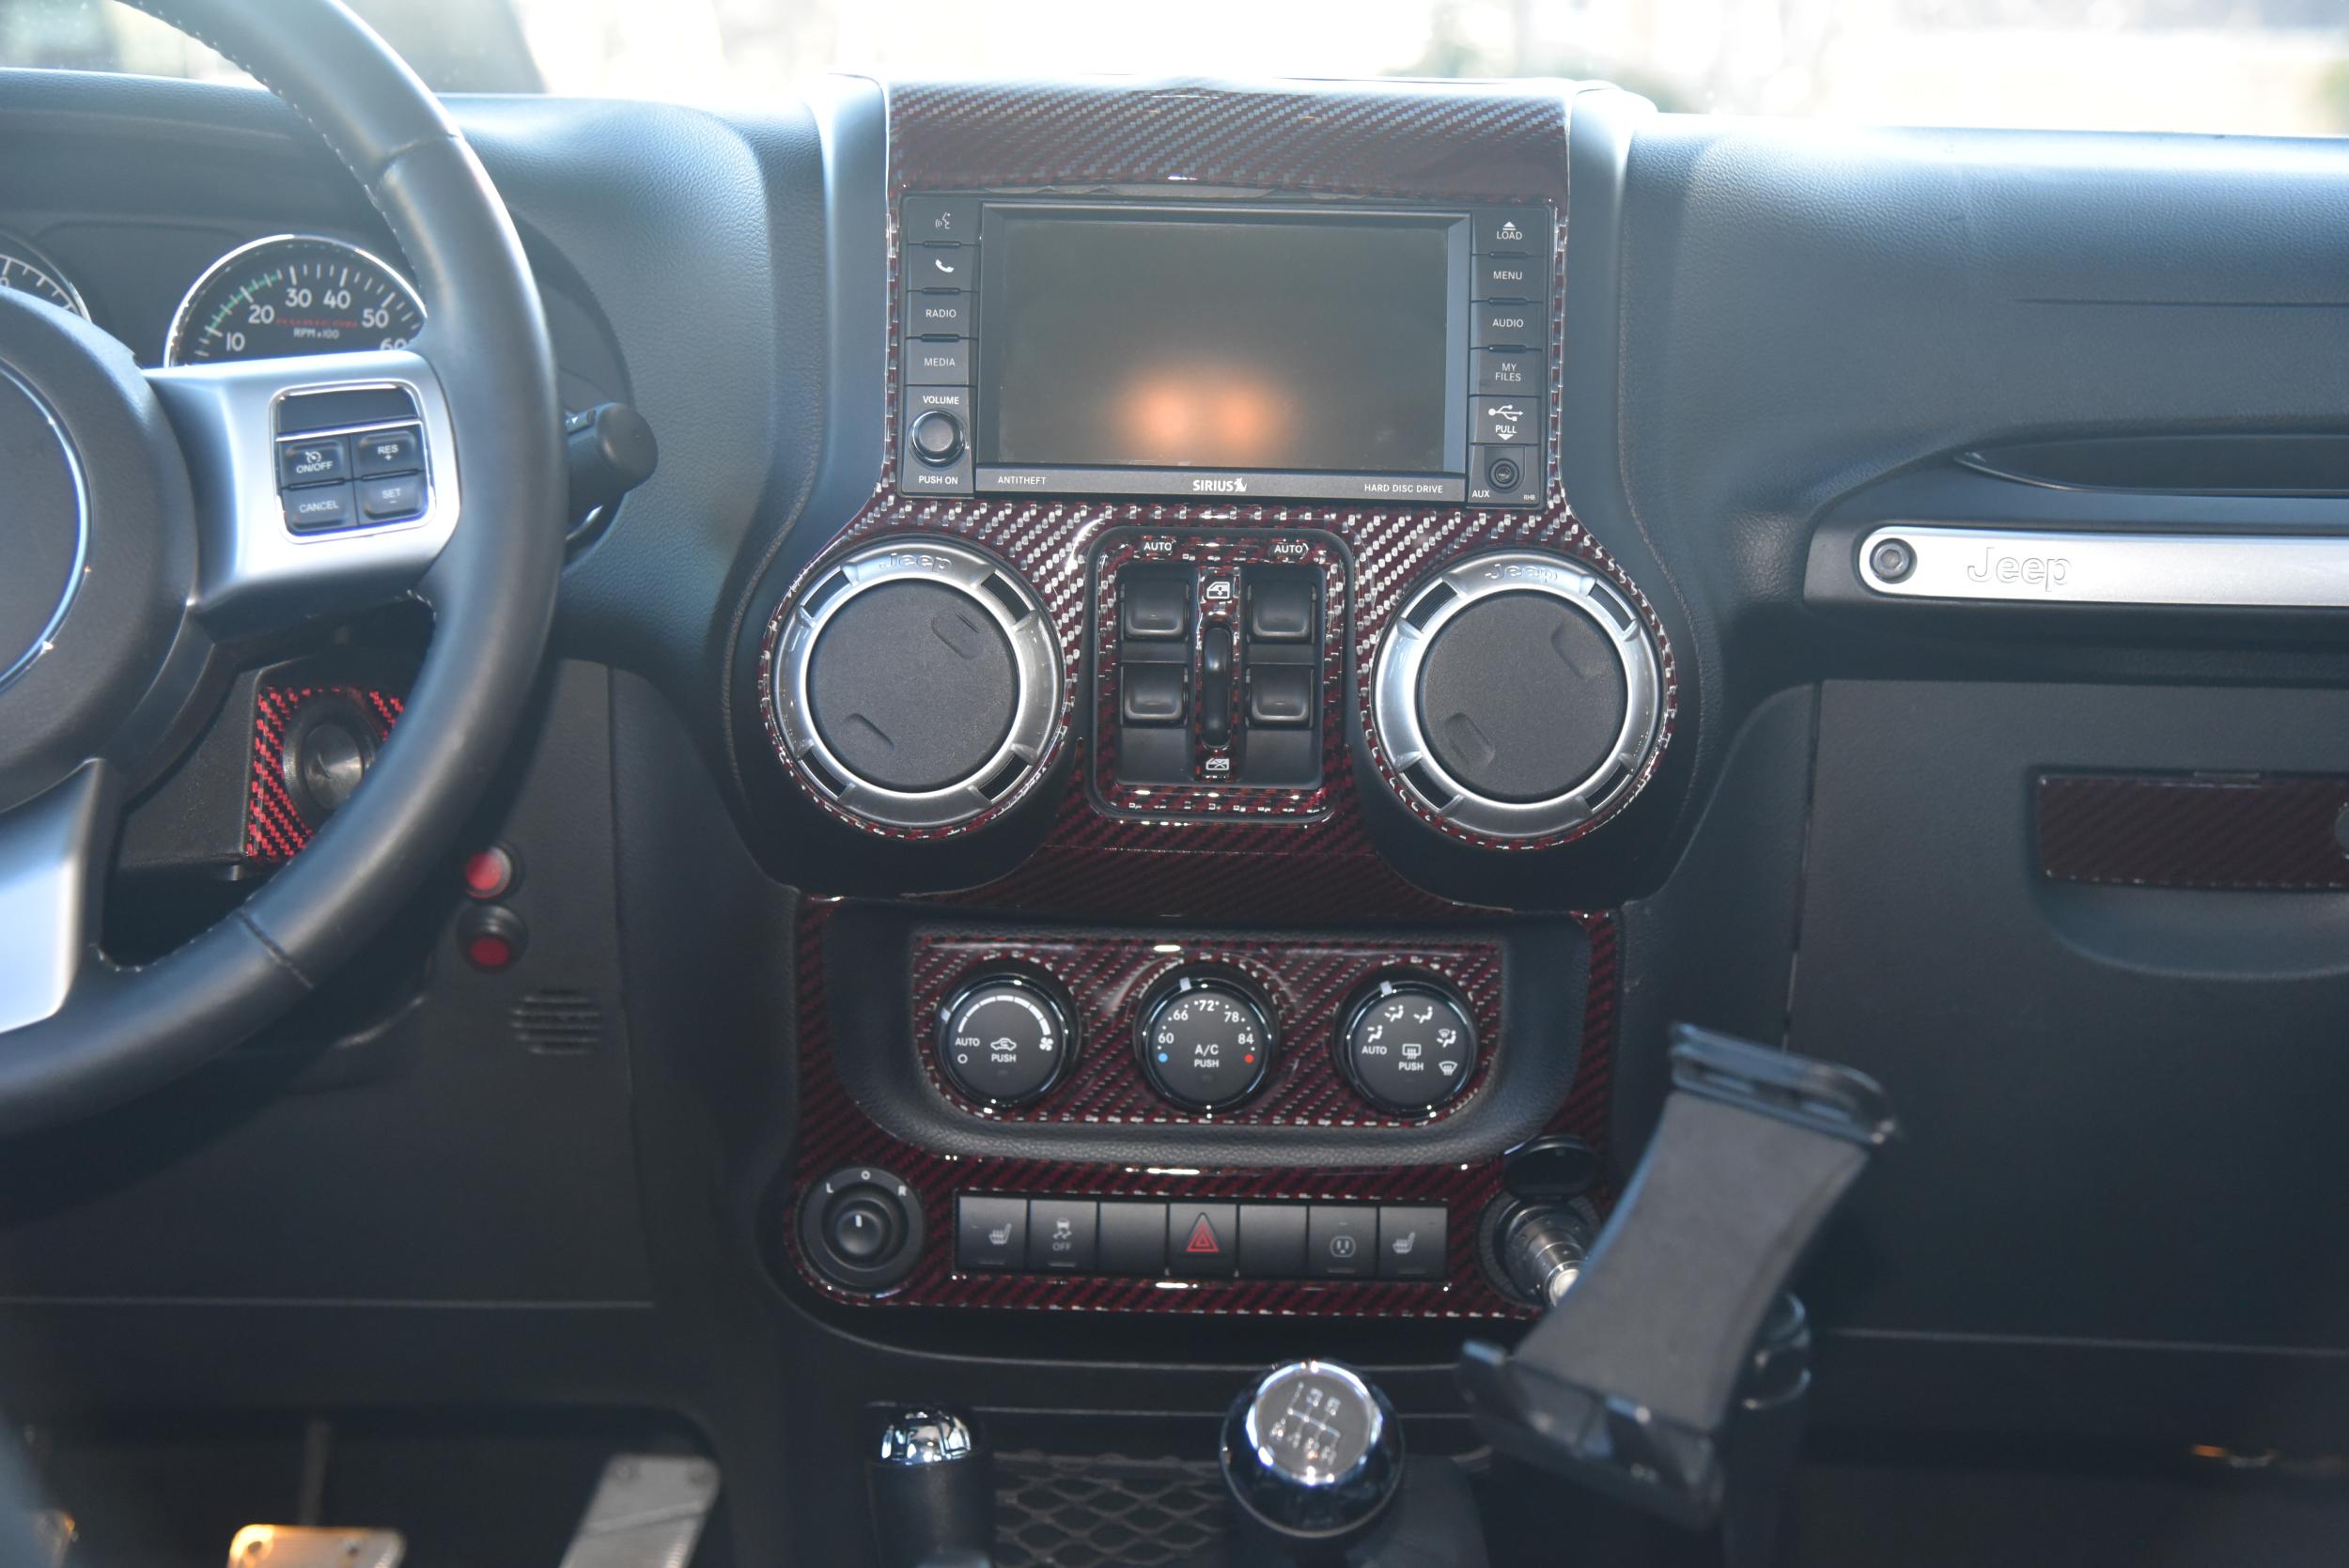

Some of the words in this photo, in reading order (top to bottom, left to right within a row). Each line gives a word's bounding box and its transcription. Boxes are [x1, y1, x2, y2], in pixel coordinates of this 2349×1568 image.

[1496, 230, 1523, 241] LOAD
[1492, 271, 1523, 281] MENU
[285, 287, 312, 308] 30
[323, 289, 350, 309] 40
[248, 304, 275, 324] 20
[362, 308, 389, 328] 50
[925, 308, 957, 318] RADIO
[1492, 318, 1524, 329] AUDIO
[293, 326, 316, 338] RPM
[226, 332, 245, 352] 10
[924, 357, 956, 367] MEDIA
[1501, 363, 1517, 372] MY
[1495, 372, 1522, 381] FILES
[923, 395, 959, 405] VOLUME
[1495, 424, 1517, 434] PULL
[377, 443, 399, 455] RES
[296, 460, 334, 474] ON/OFF
[918, 474, 942, 485] PUSH
[944, 475, 958, 485] ON
[997, 475, 1047, 486] ANTITHEFT
[1192, 479, 1234, 492] SIRIUS
[1364, 483, 1390, 492] HARD
[1392, 484, 1414, 493] DISC
[1416, 484, 1443, 494] DRIVE
[381, 488, 401, 499] SET
[1471, 489, 1490, 498] AUX
[299, 500, 339, 513] CANCEL
[1143, 541, 1173, 551] AUTO
[1274, 544, 1303, 553] AUTO
[1967, 546, 2073, 593] Jeep
[1199, 1000, 1215, 1012] 72
[1173, 1009, 1189, 1021] 66
[1224, 1011, 1239, 1023] 78
[955, 1037, 980, 1048] AUTO
[1158, 1032, 1174, 1044] 60
[1237, 1032, 1254, 1045] 84
[1194, 1044, 1219, 1057] A/C
[1361, 1045, 1388, 1055] AUTO
[990, 1053, 1017, 1063] PUSH
[1193, 1059, 1220, 1068] PUSH
[1398, 1062, 1424, 1071] PUSH
[897, 1185, 908, 1197] R
[1051, 1241, 1071, 1251] OFF
